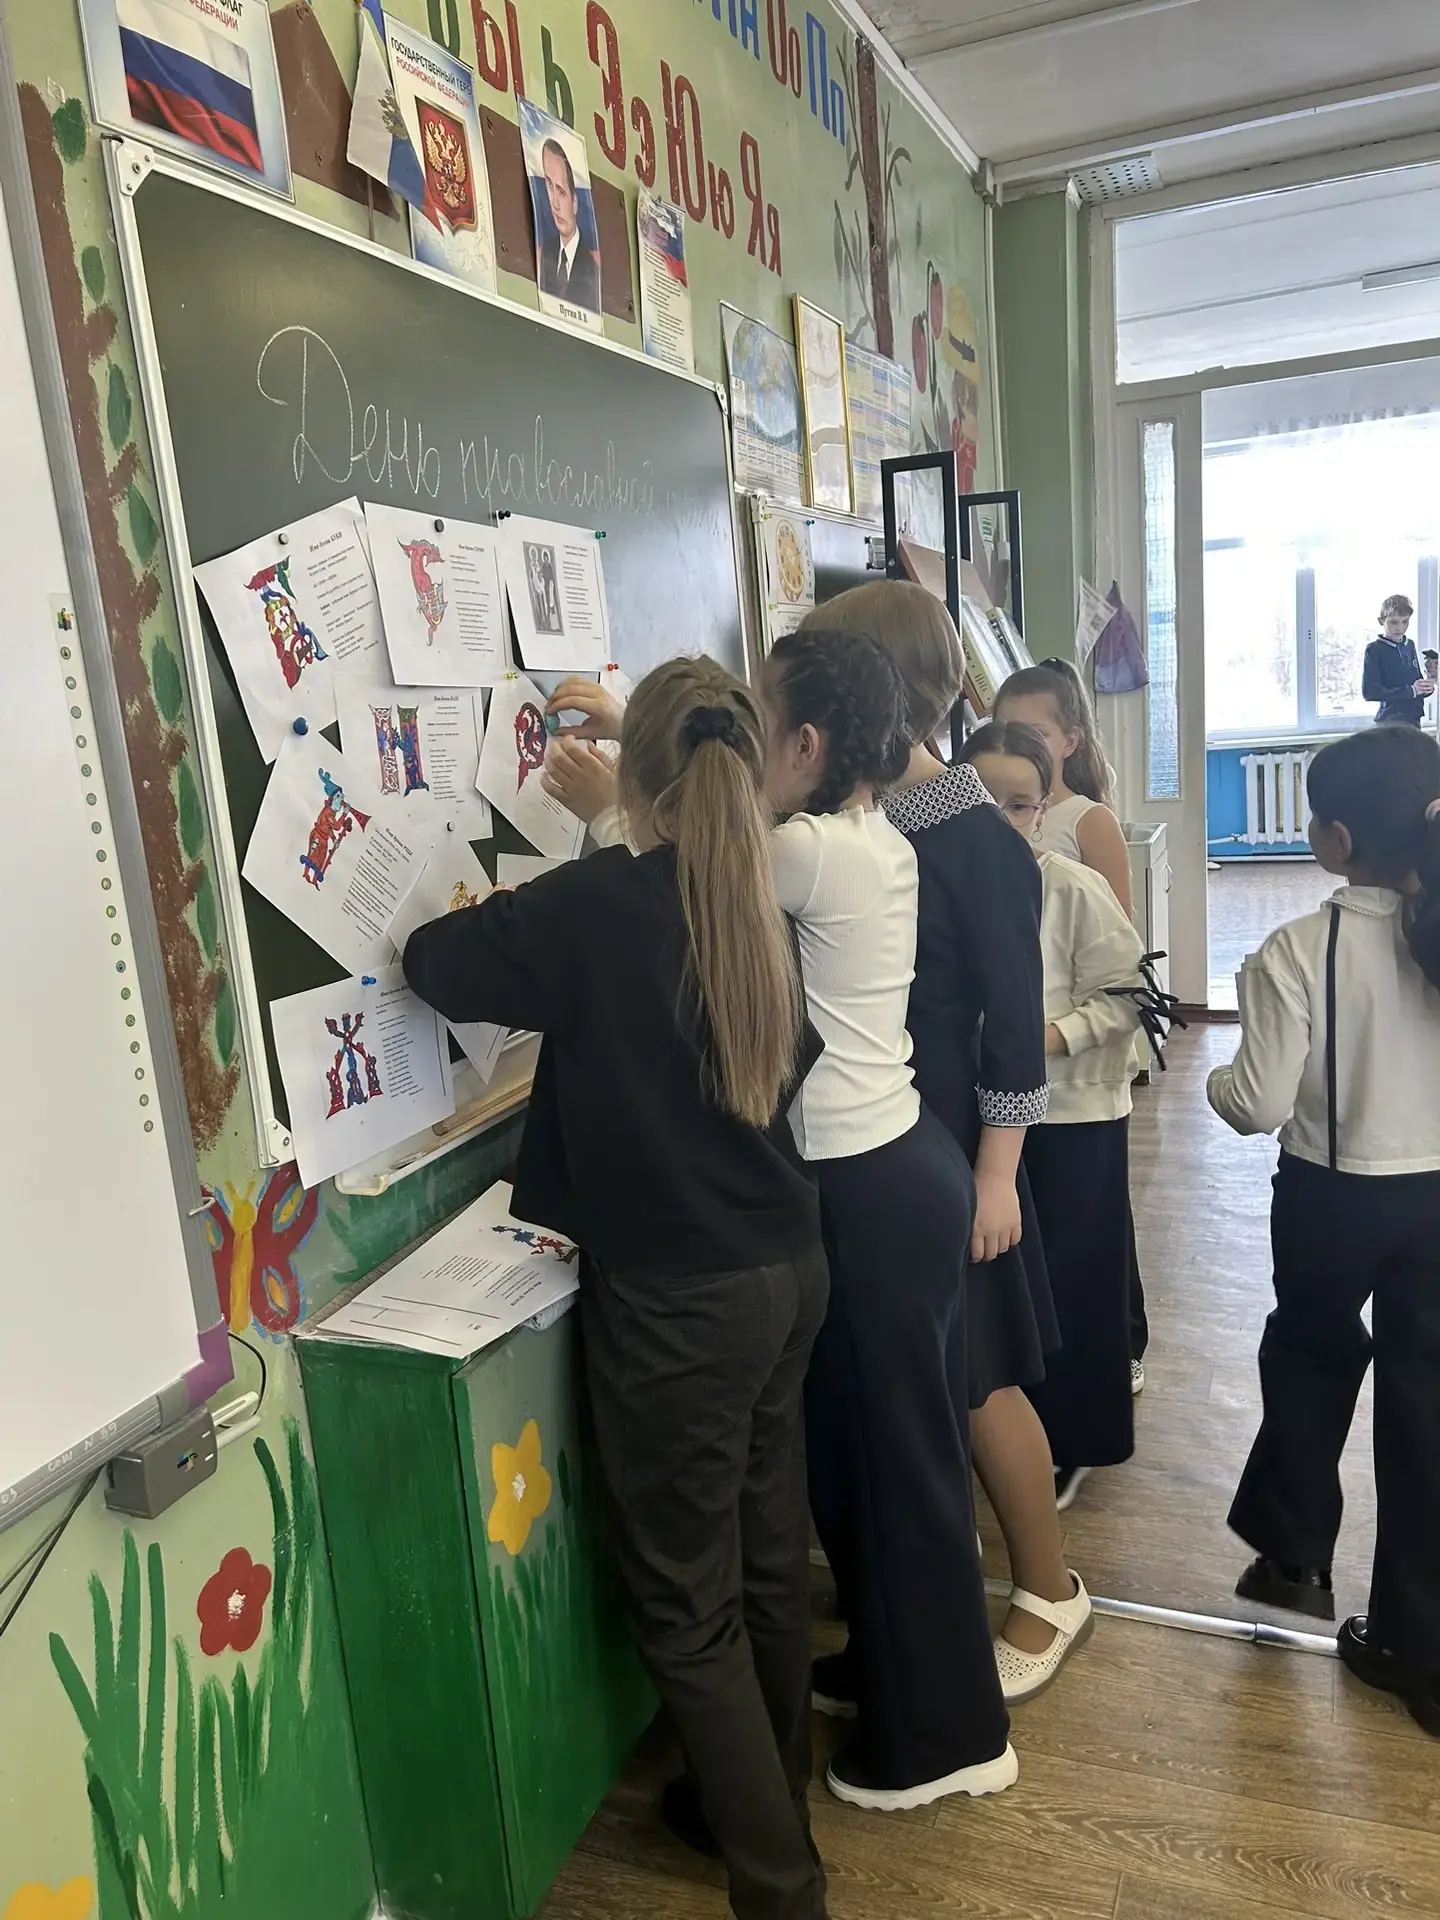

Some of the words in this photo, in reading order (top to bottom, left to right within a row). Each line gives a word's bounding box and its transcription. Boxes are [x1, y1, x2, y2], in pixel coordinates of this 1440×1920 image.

[390, 36, 456, 87] ГОСУДАРСТВЕННЫЙ
[395, 55, 437, 89] РОССИЙСКОЙ
[806, 11, 846, 147] Пп
[660, 59, 735, 240] Юю
[740, 130, 782, 277] Яя
[257, 325, 441, 498] День
